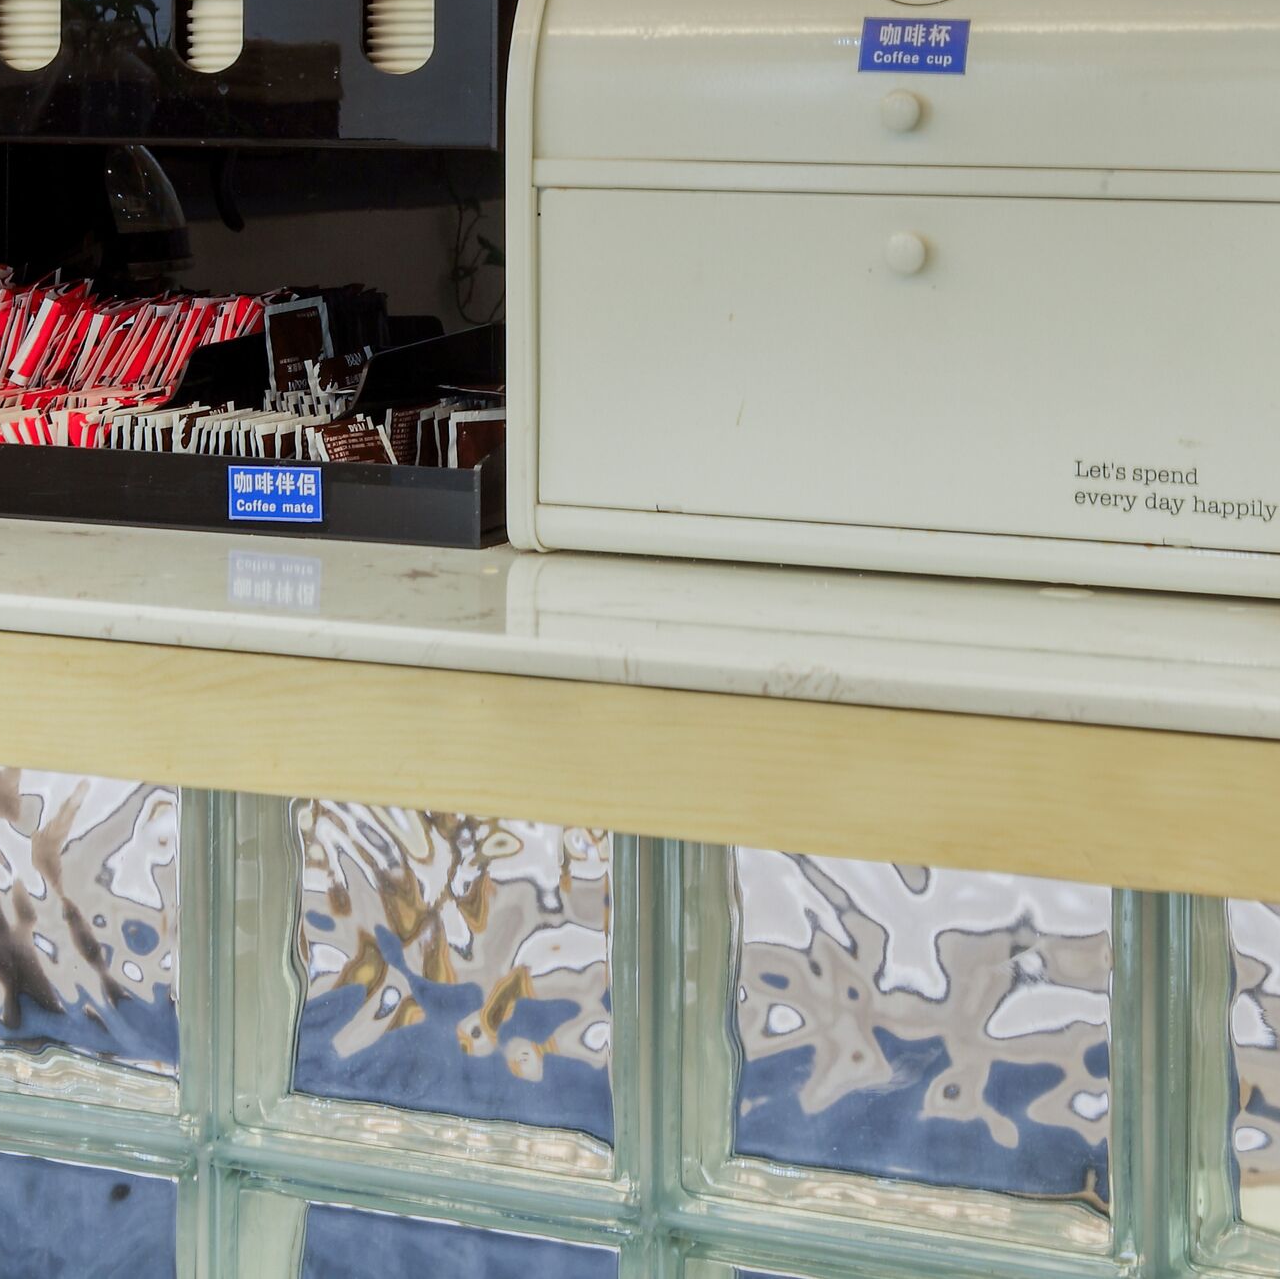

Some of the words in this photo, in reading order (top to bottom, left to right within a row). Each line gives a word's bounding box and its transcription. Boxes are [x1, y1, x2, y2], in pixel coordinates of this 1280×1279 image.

[879, 23, 952, 47] 咖啡杯
[873, 50, 919, 64] Coffee
[926, 54, 952, 67] cup
[233, 471, 316, 496] 咖啡伴侣
[1074, 460, 1126, 481] Let's
[1132, 467, 1199, 486] spend
[236, 499, 276, 512] Coffee
[282, 503, 314, 513] mate
[1074, 490, 1138, 513] every
[1144, 492, 1185, 515] day
